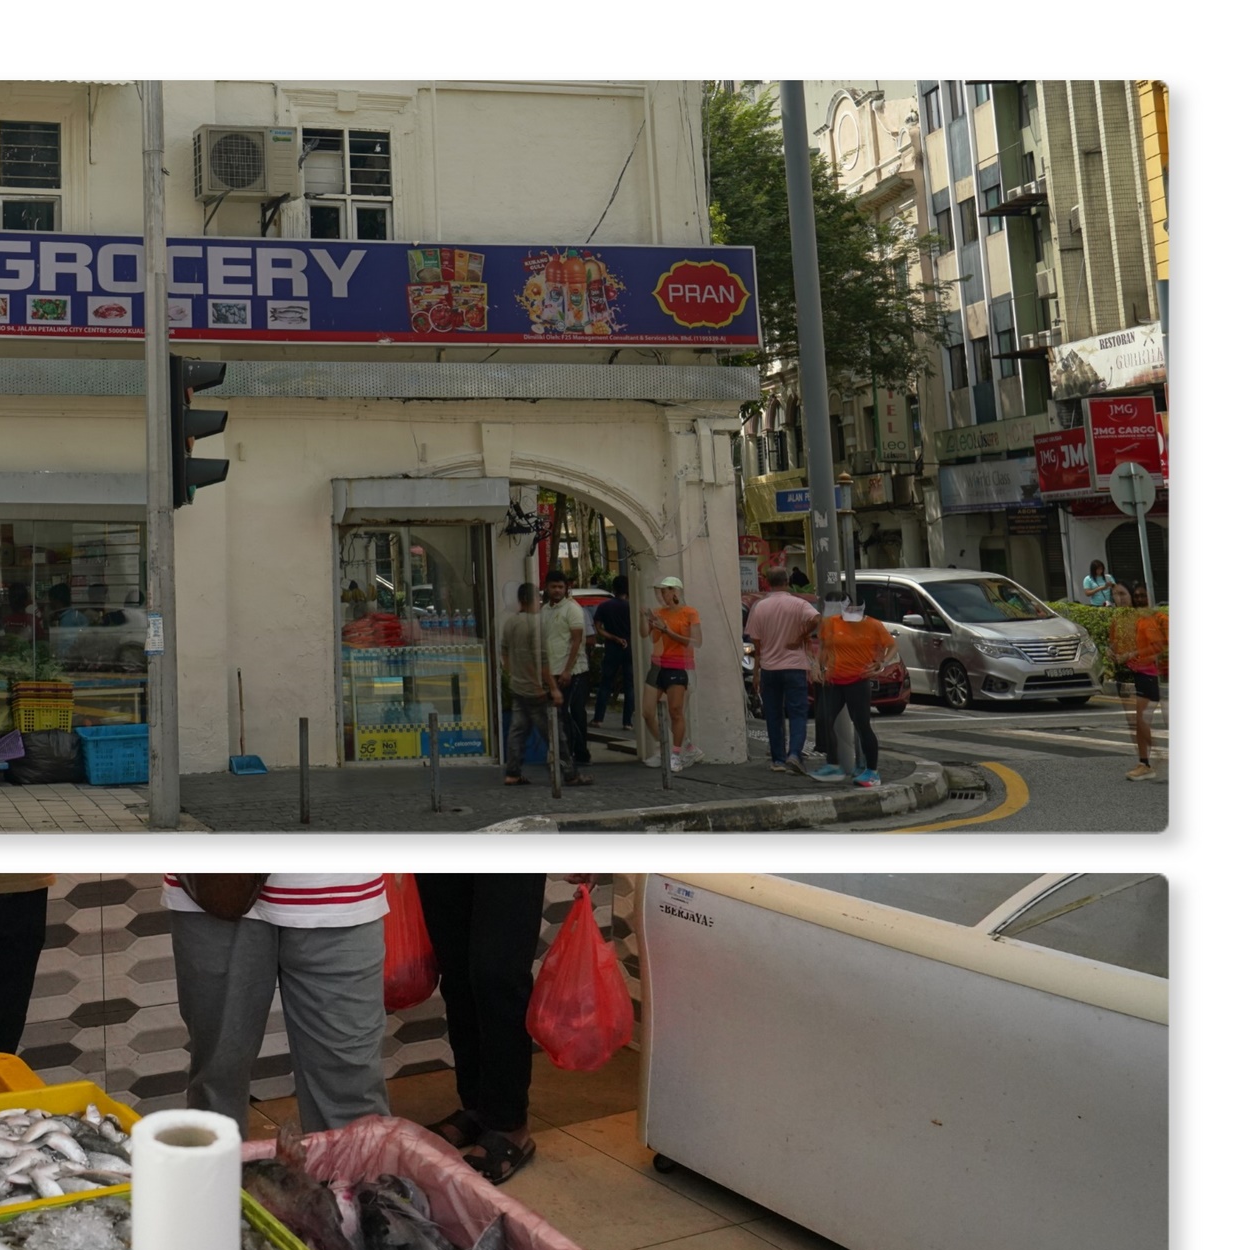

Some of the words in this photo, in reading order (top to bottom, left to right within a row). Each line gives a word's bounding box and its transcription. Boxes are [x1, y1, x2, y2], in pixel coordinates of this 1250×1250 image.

[668, 283, 735, 304] PRAN
[38, 326, 69, 334] PETALING
[572, 334, 609, 342] Management
[1098, 331, 1136, 351] RESTORAN
[1109, 403, 1134, 416] JMG
[1093, 427, 1116, 436] JMG
[1118, 426, 1156, 435] CARGO
[1039, 449, 1056, 467] JMG
[991, 470, 1012, 486] Class
[787, 492, 804, 503] JALAN
[360, 743, 376, 754] 5G
[664, 904, 708, 927] BERJAYA
